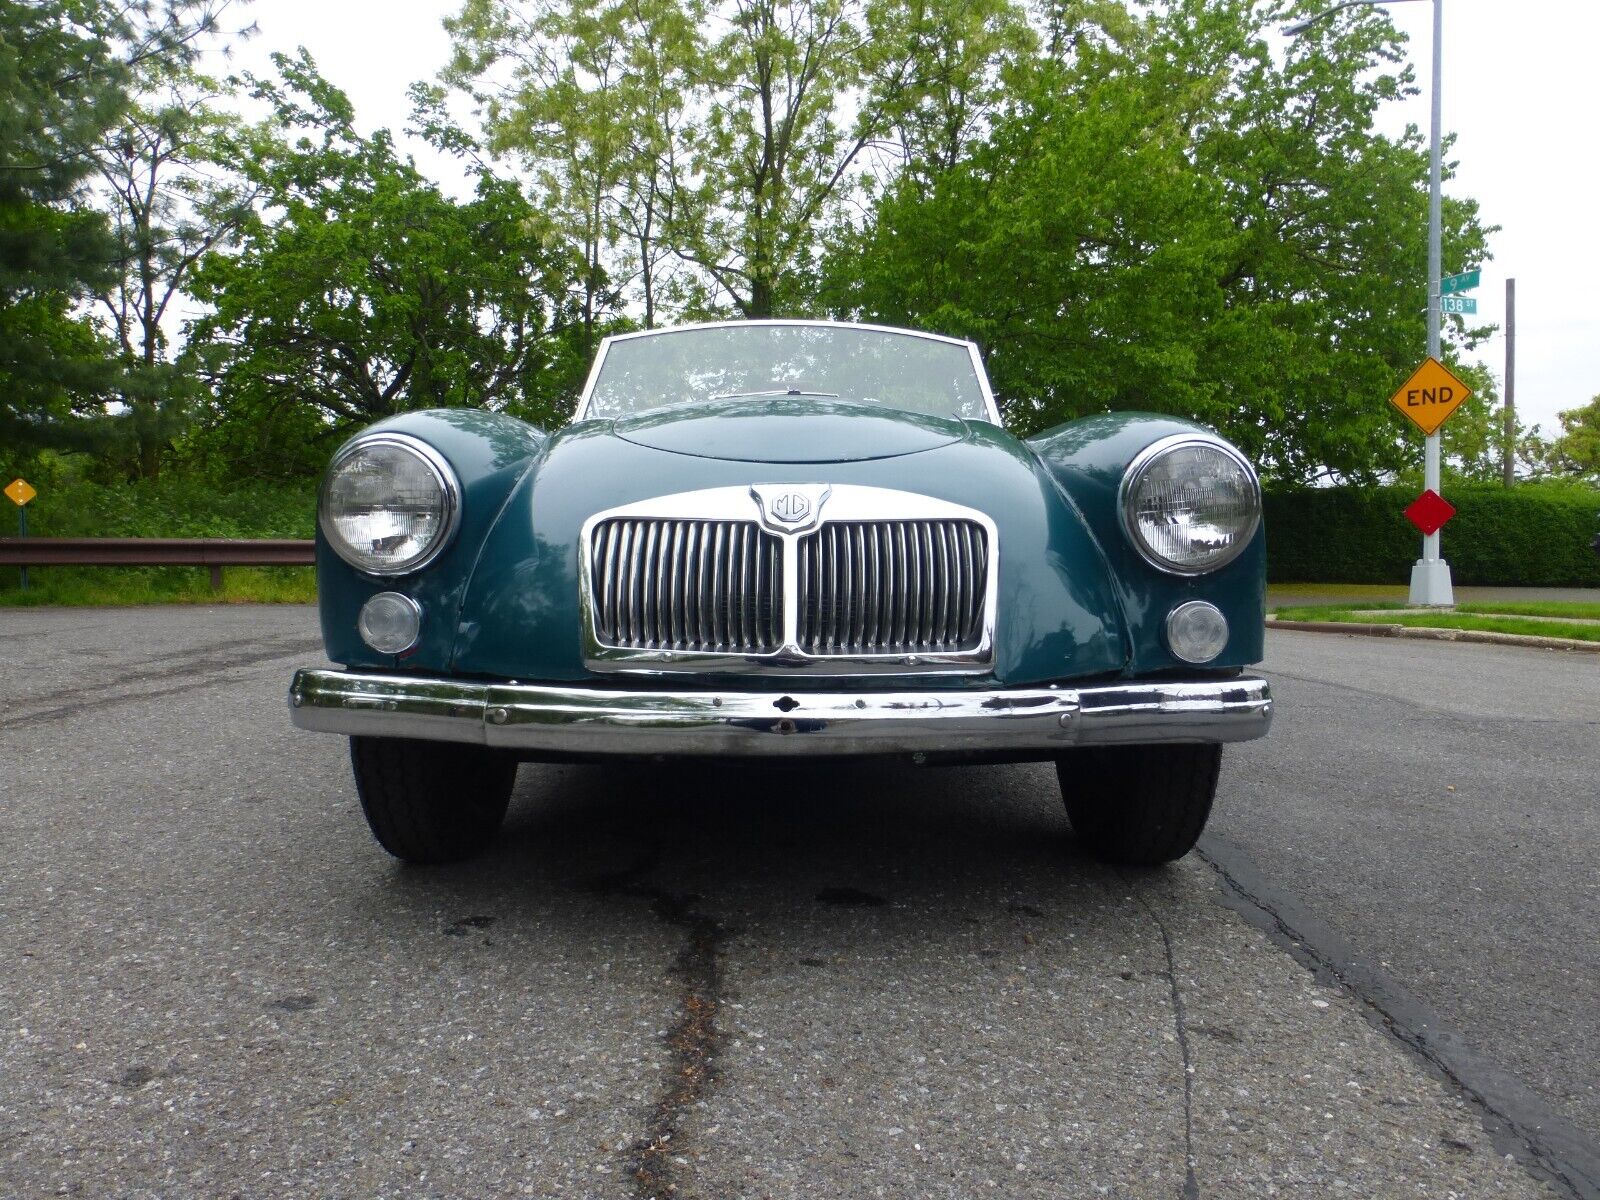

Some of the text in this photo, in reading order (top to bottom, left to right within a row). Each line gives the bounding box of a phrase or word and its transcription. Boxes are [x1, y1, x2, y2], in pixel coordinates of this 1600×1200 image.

[1449, 274, 1471, 291] 9 AV
[1443, 298, 1474, 312] 138 ST
[1407, 386, 1454, 407] END
[776, 494, 805, 515] MG
